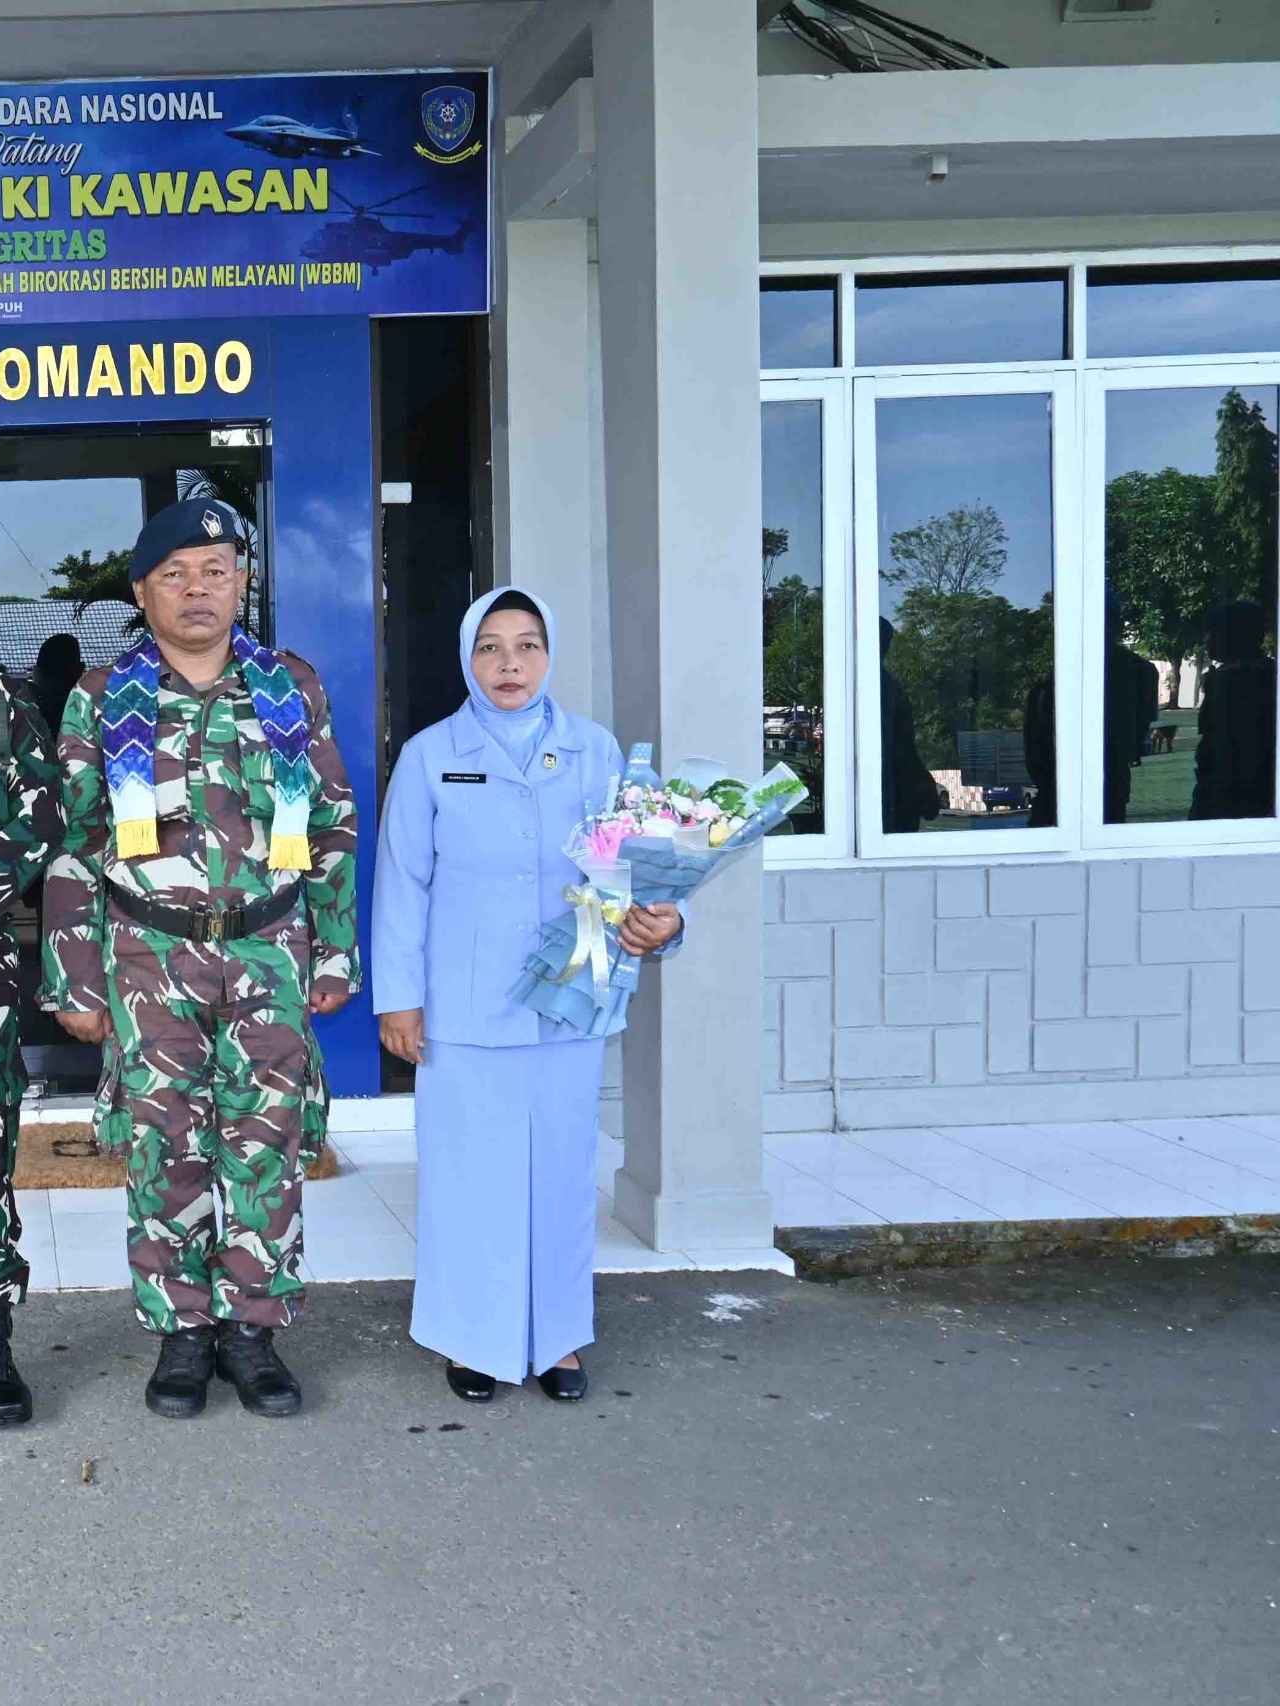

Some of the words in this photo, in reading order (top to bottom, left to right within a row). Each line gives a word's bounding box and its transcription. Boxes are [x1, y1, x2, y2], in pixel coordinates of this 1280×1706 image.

[81, 91, 223, 123] NASIONAL
[70, 167, 329, 218] KAWASAN
[18, 268, 106, 294] BIROKRASI
[109, 266, 167, 291] BERSIH
[171, 265, 207, 289] DAN
[211, 263, 296, 288] MELAYANI
[299, 261, 362, 292] (WBBM)
